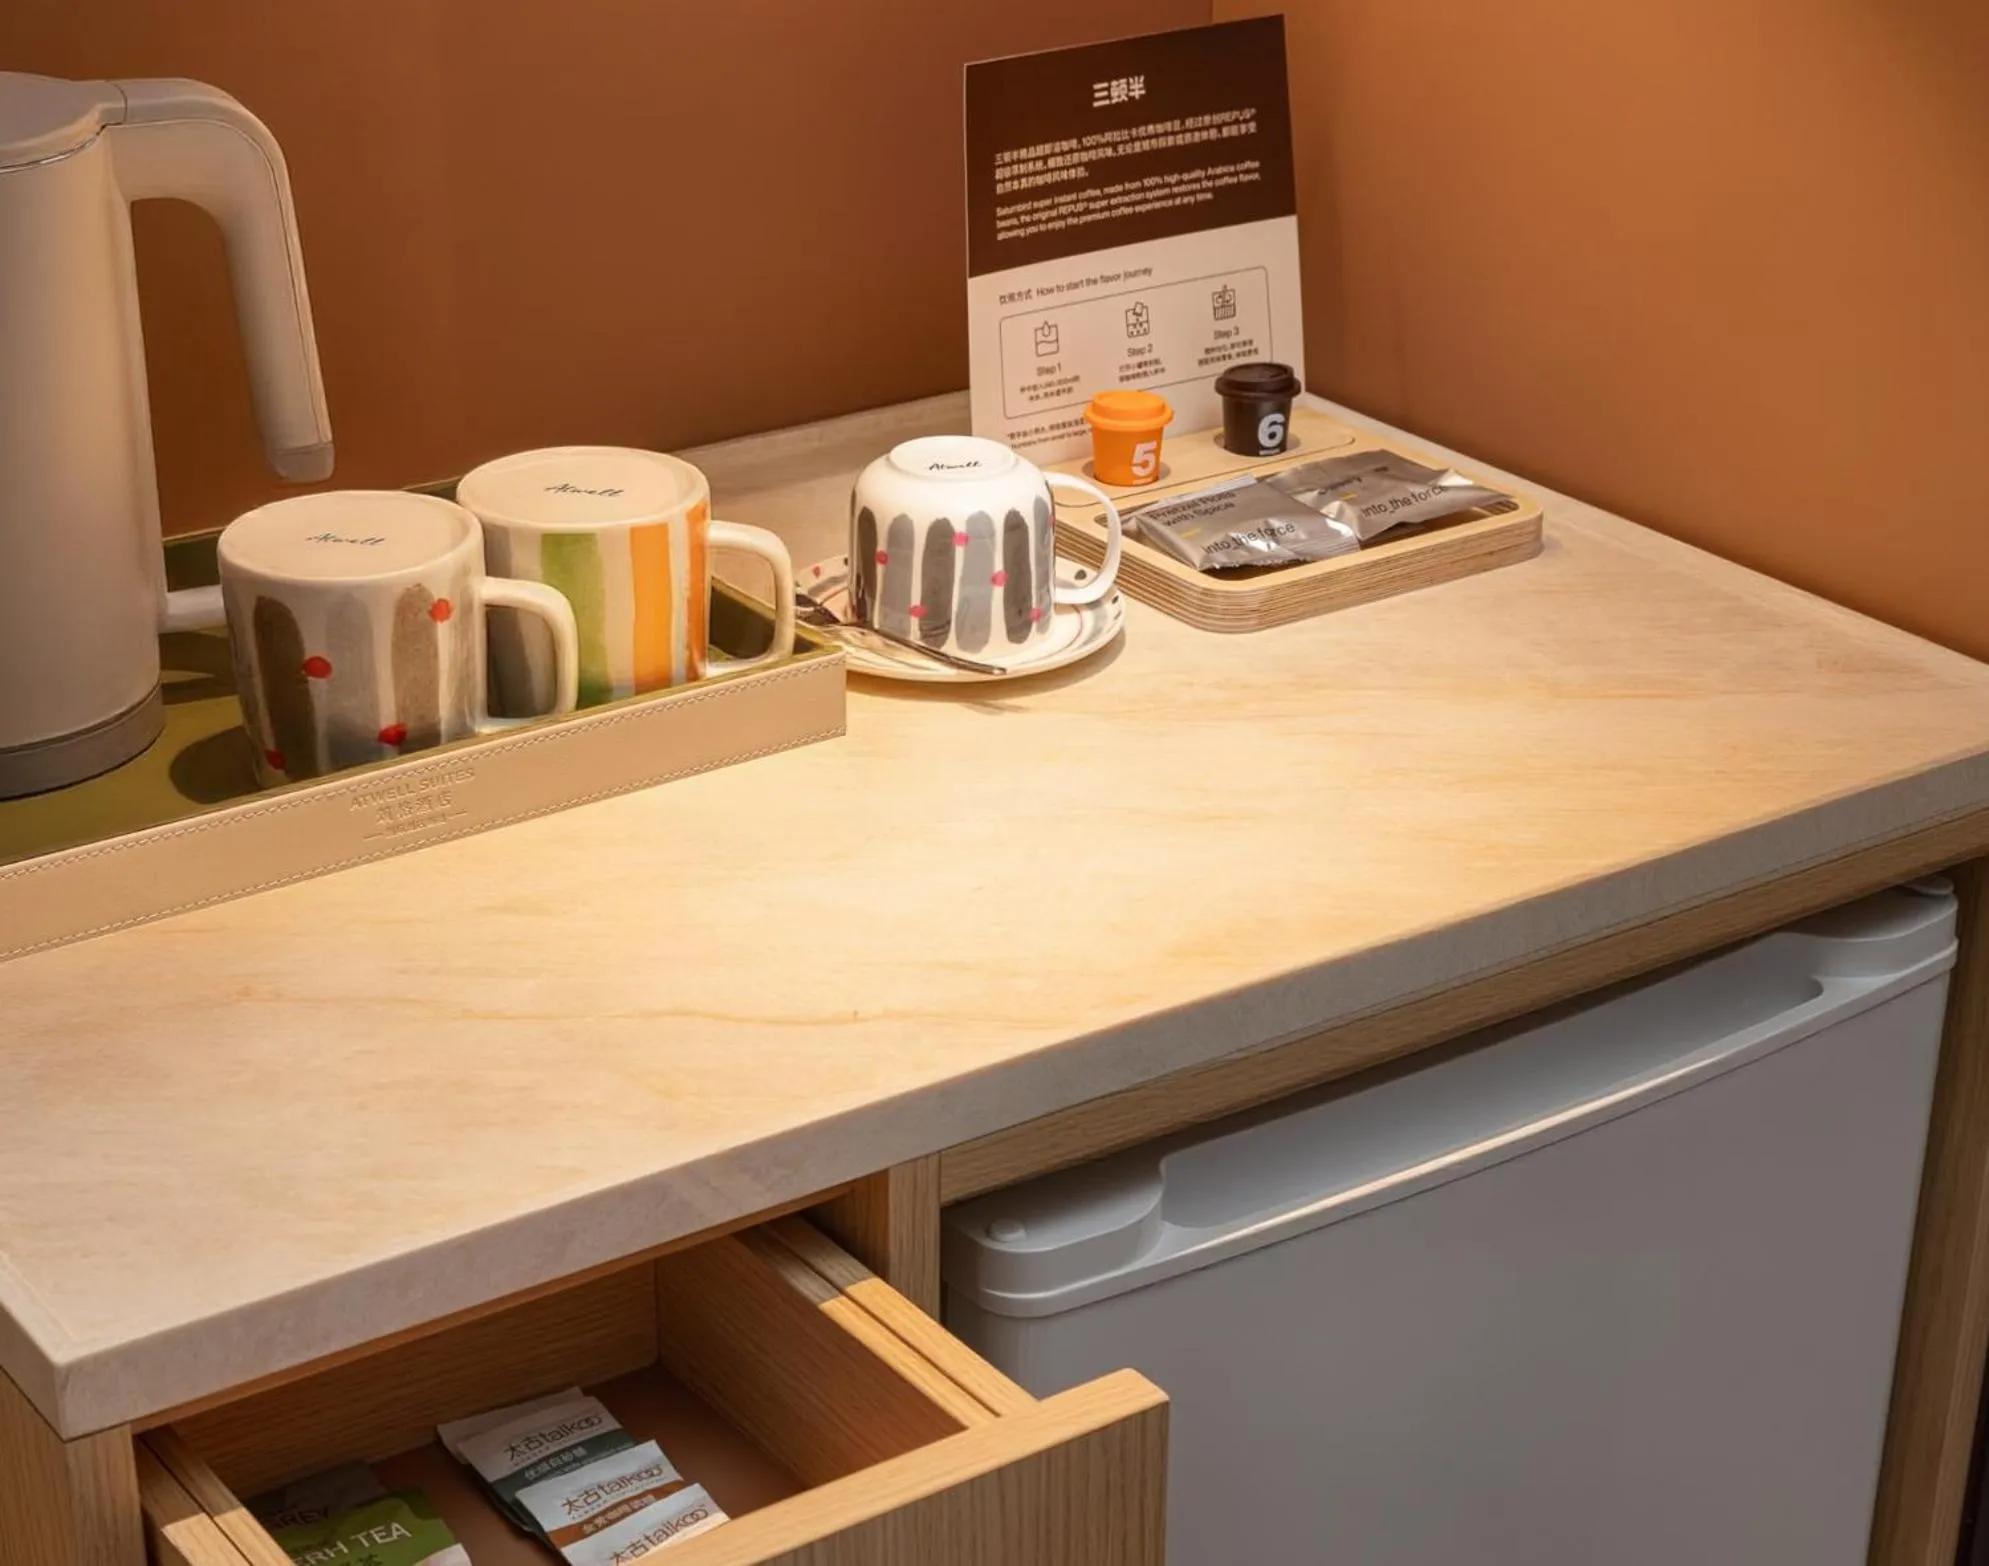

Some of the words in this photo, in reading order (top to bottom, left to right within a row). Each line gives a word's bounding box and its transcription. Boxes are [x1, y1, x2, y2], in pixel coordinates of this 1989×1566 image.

[1092, 74, 1146, 108] 三顿半
[1036, 286, 1055, 298] How
[1056, 284, 1065, 293] to
[1066, 279, 1085, 291] start
[1085, 276, 1098, 288] the
[1100, 272, 1122, 284] flavor
[1123, 267, 1153, 282] journey
[1213, 328, 1233, 341] Step
[1233, 325, 1240, 336] 3
[1127, 345, 1147, 358] Step
[1147, 342, 1154, 354] 2
[1036, 364, 1057, 377] Step
[1057, 362, 1062, 372] 1
[1258, 413, 1286, 448] 6
[1131, 440, 1158, 477] 5
[350, 784, 417, 811] ATWELL
[419, 767, 476, 793] SUITES
[351, 1522, 412, 1548] TEA
